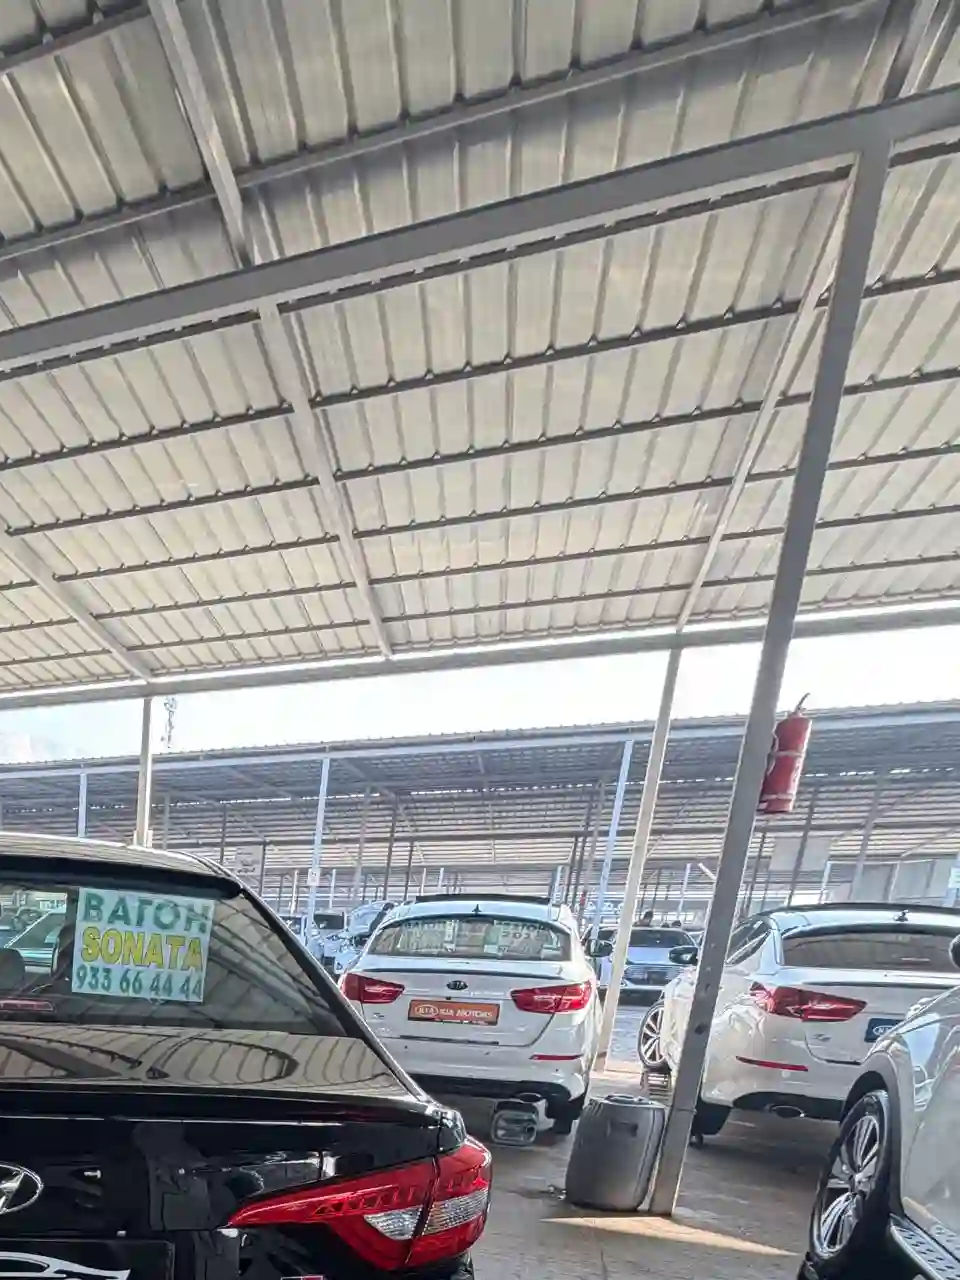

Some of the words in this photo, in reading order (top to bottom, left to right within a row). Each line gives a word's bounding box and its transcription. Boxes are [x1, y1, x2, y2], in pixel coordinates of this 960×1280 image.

[83, 892, 211, 934] ВАГОН
[80, 926, 204, 972] SONATA
[76, 965, 112, 992] 933
[119, 968, 144, 994] 66
[149, 971, 173, 998] 44
[179, 973, 203, 1000] 44
